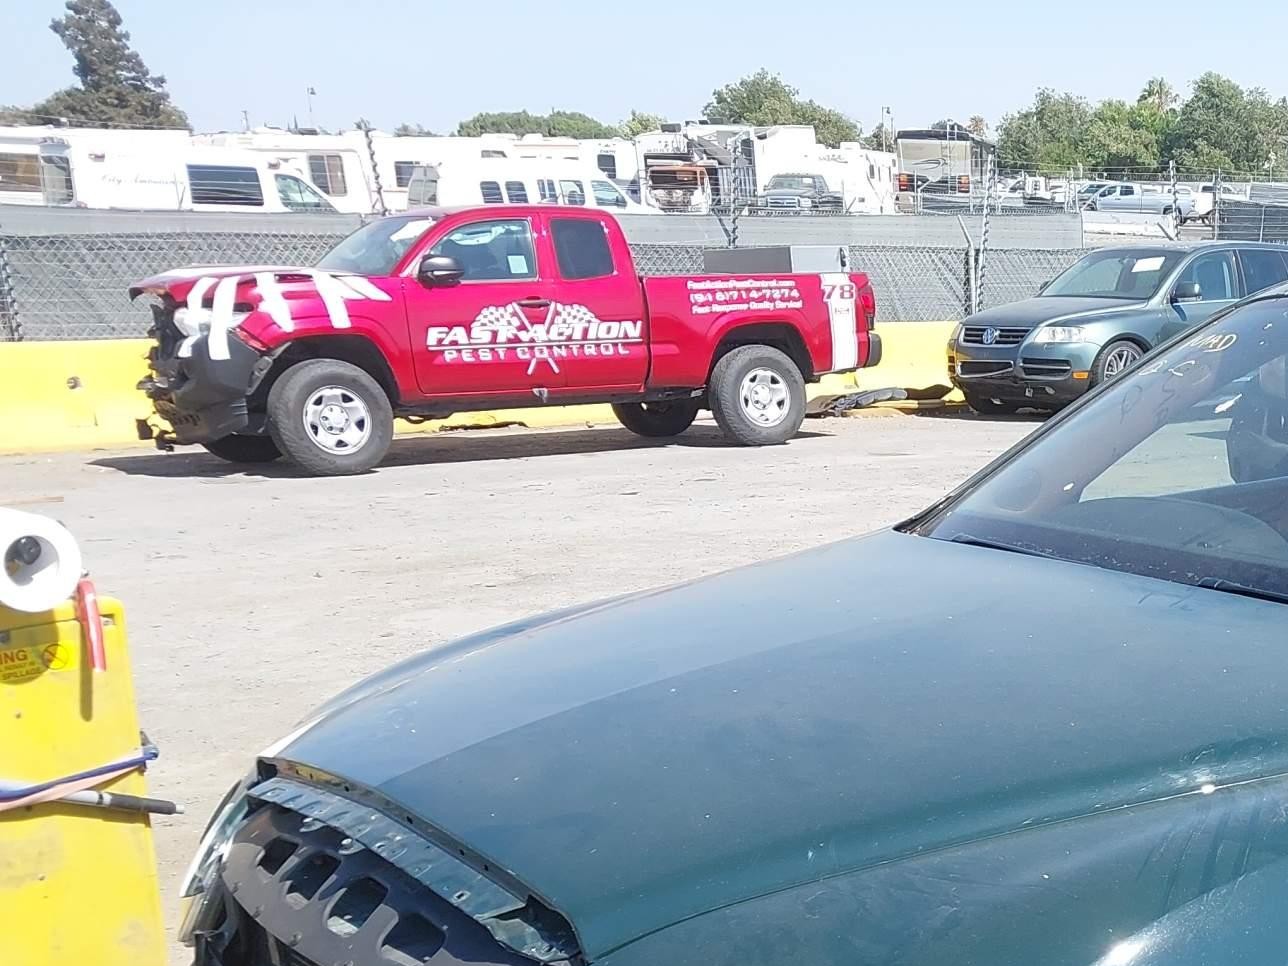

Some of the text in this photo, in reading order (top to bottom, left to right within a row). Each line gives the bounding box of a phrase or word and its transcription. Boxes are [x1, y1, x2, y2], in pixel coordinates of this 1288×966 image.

[823, 284, 856, 301] 78
[750, 301, 774, 310] Quality
[426, 320, 643, 345] FAST ACTION
[444, 343, 631, 362] PEST CONTROL
